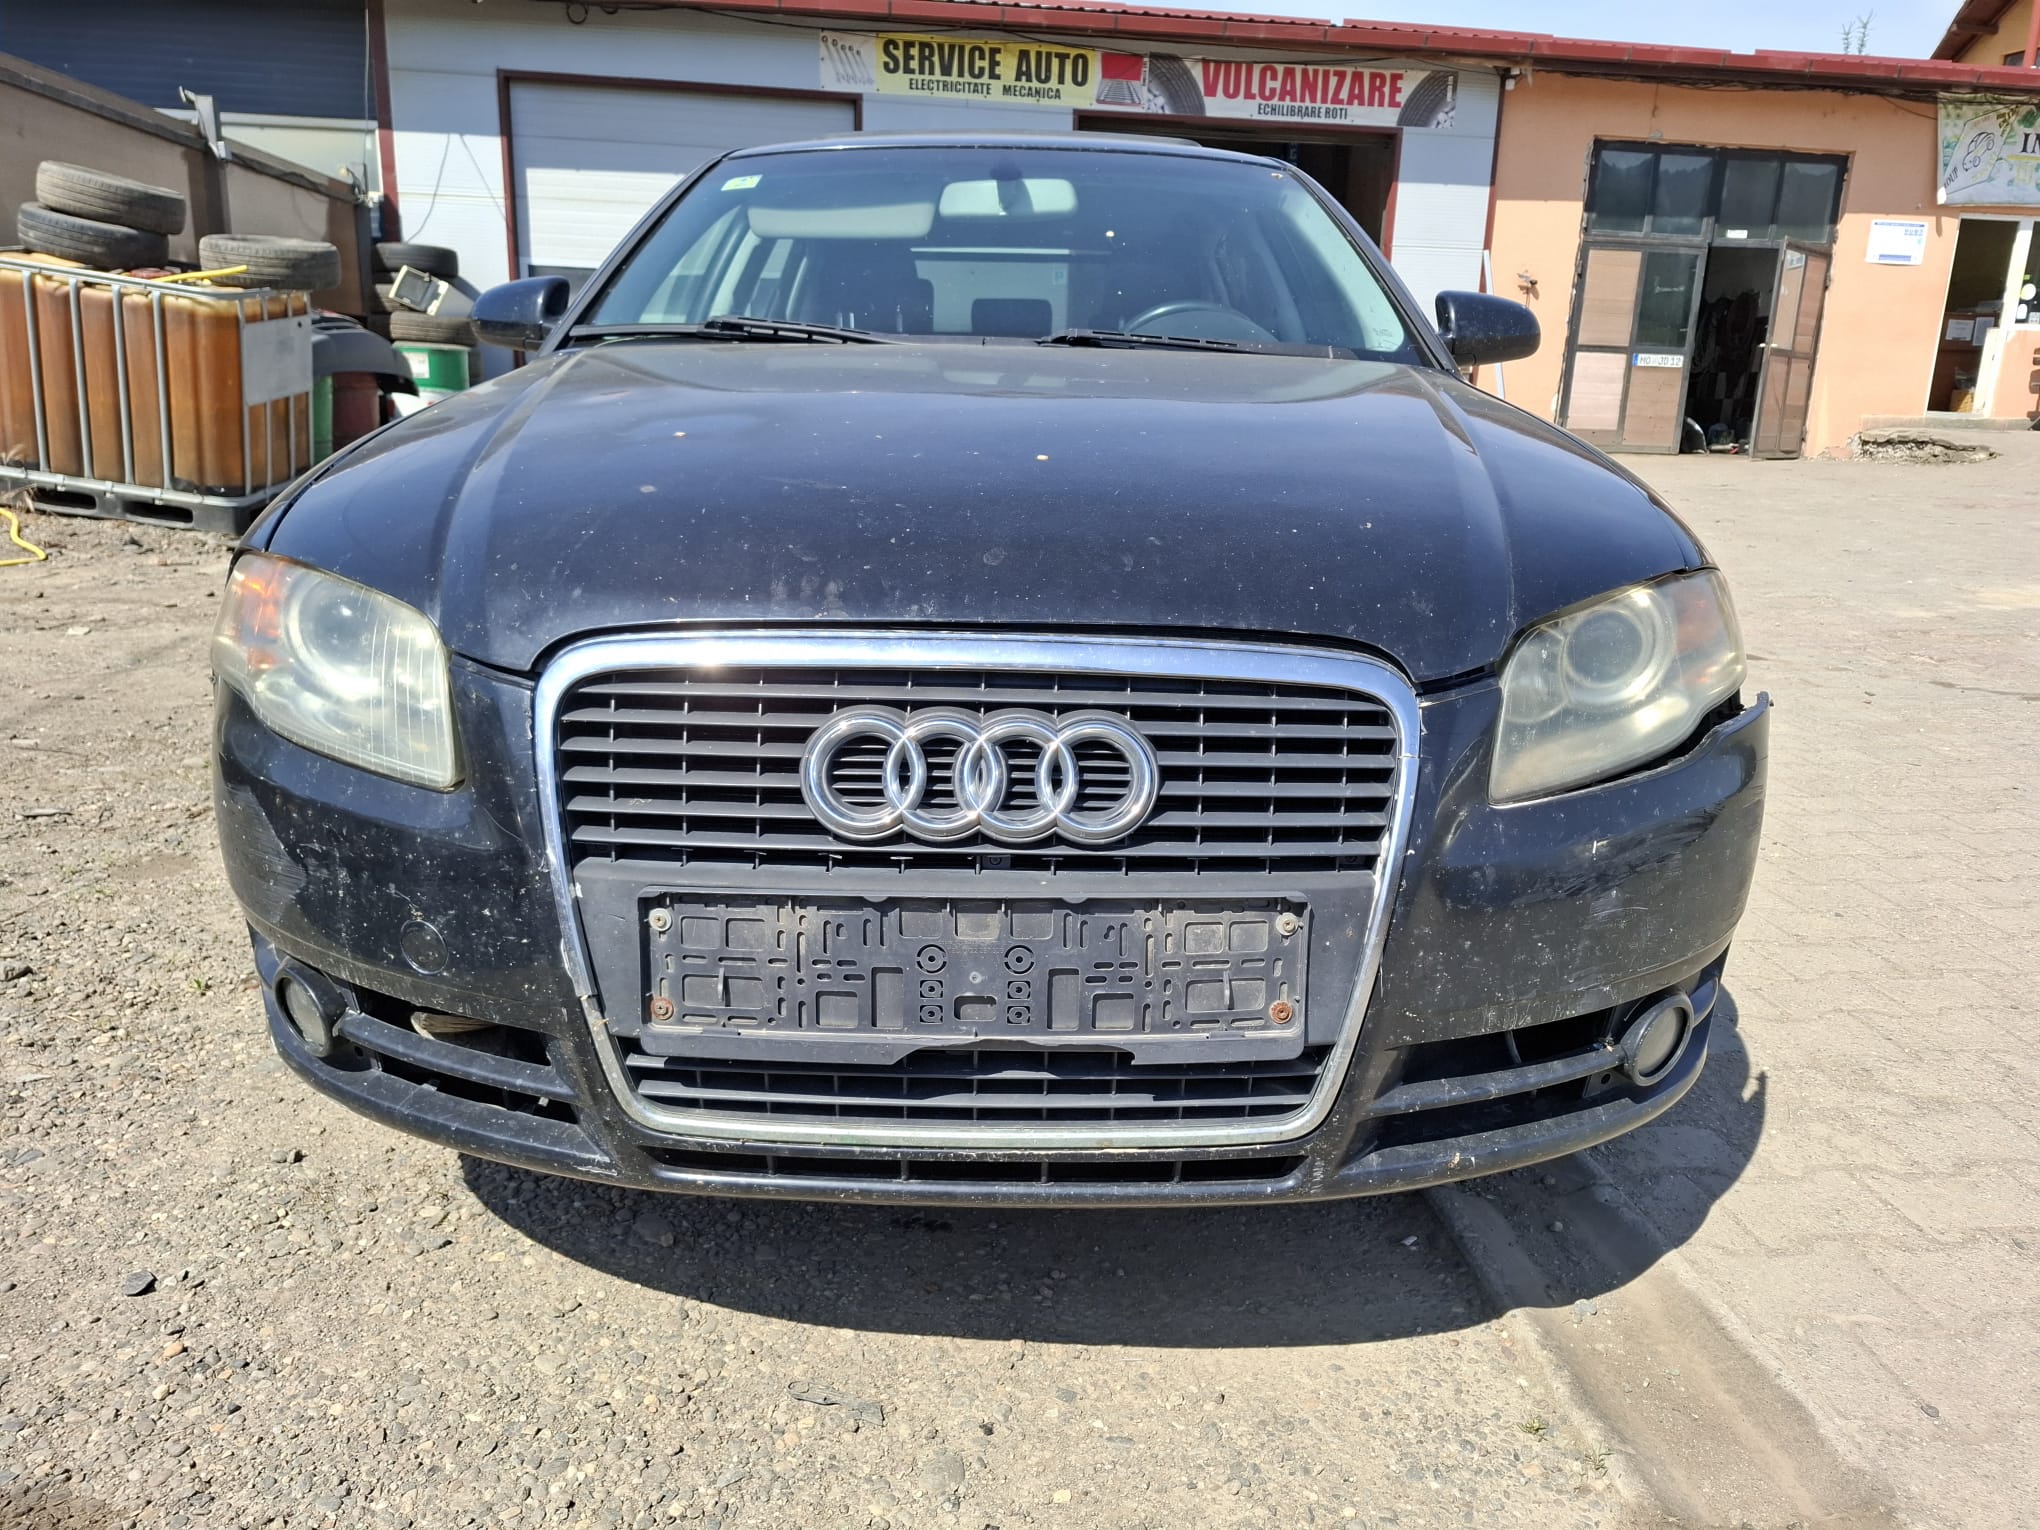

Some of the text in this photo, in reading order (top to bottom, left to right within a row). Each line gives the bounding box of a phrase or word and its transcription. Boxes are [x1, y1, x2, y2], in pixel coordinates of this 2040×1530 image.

[883, 38, 1089, 87] SERVICE AUTO
[909, 78, 992, 96] ELECTRICITATE
[1201, 62, 1404, 108] VULCANIZARE
[1257, 103, 1348, 120] ECHILIBRARE ROTI
